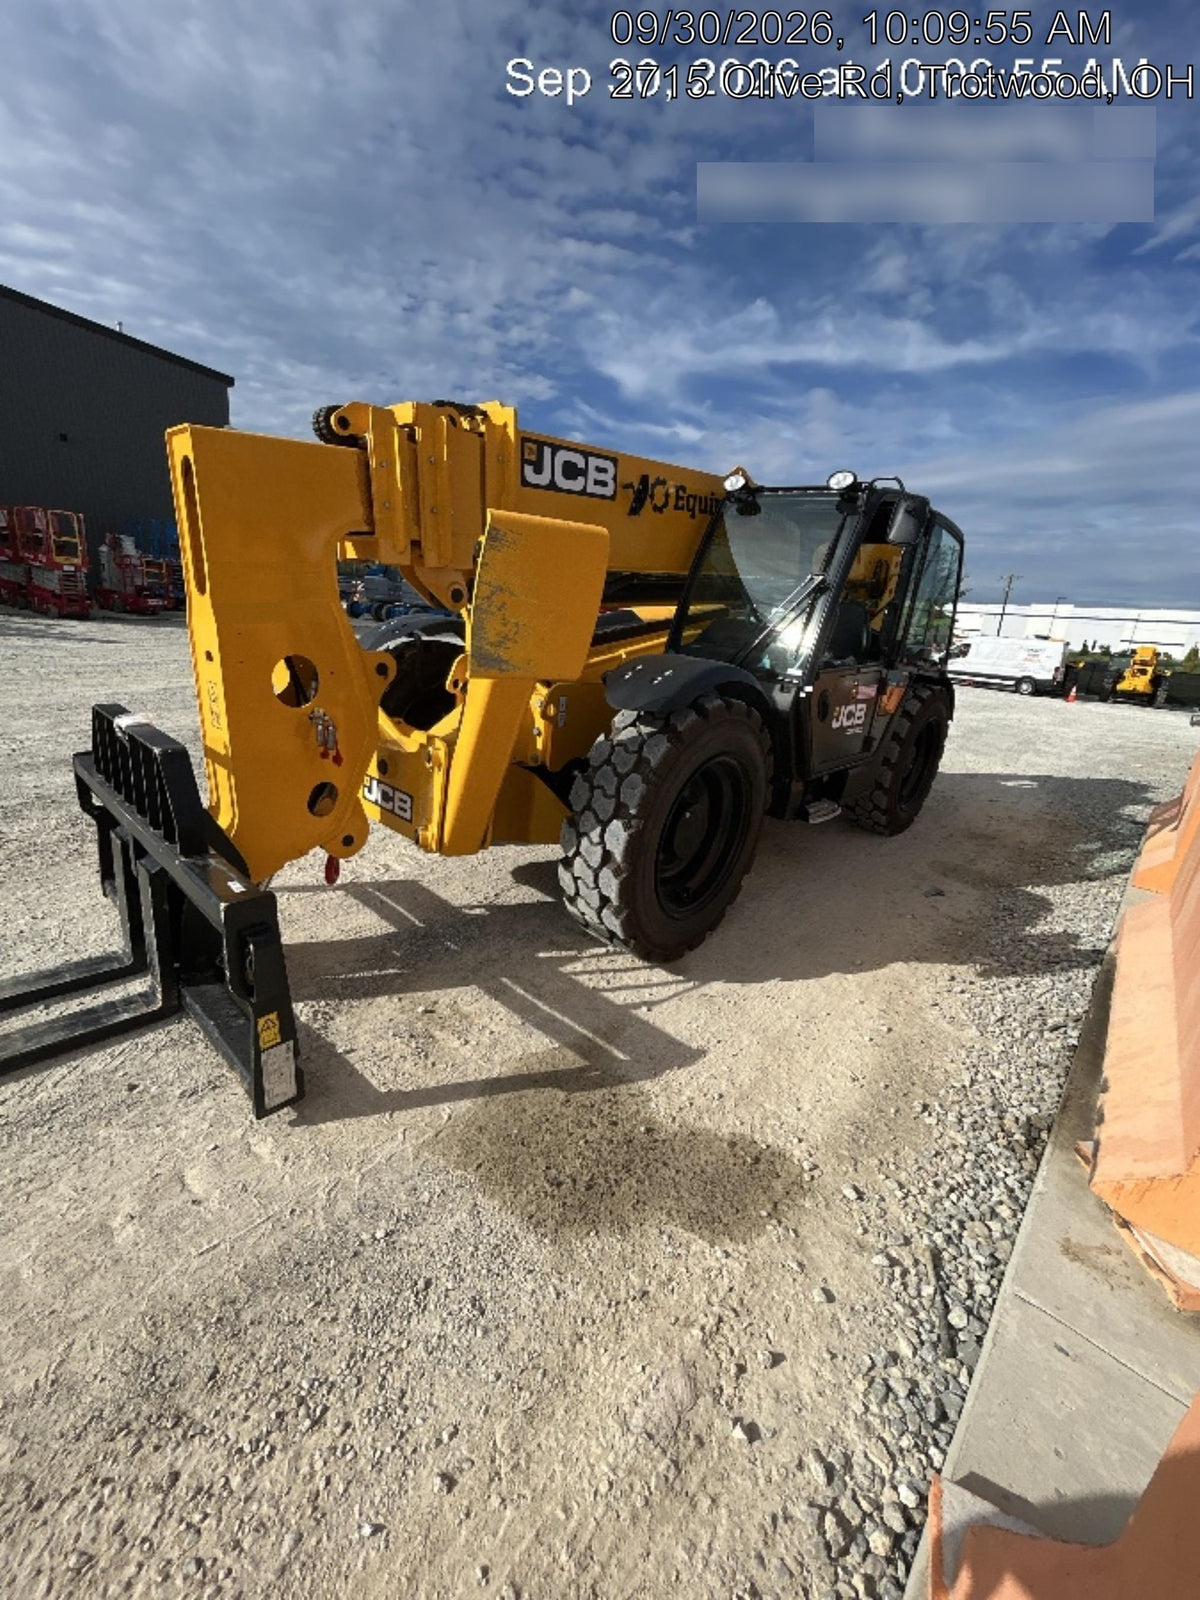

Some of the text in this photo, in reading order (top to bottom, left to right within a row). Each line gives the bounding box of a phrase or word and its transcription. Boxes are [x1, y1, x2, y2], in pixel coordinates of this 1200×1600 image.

[524, 445, 616, 497] JCB
[832, 703, 867, 729] JCB
[363, 779, 412, 821] JCB
